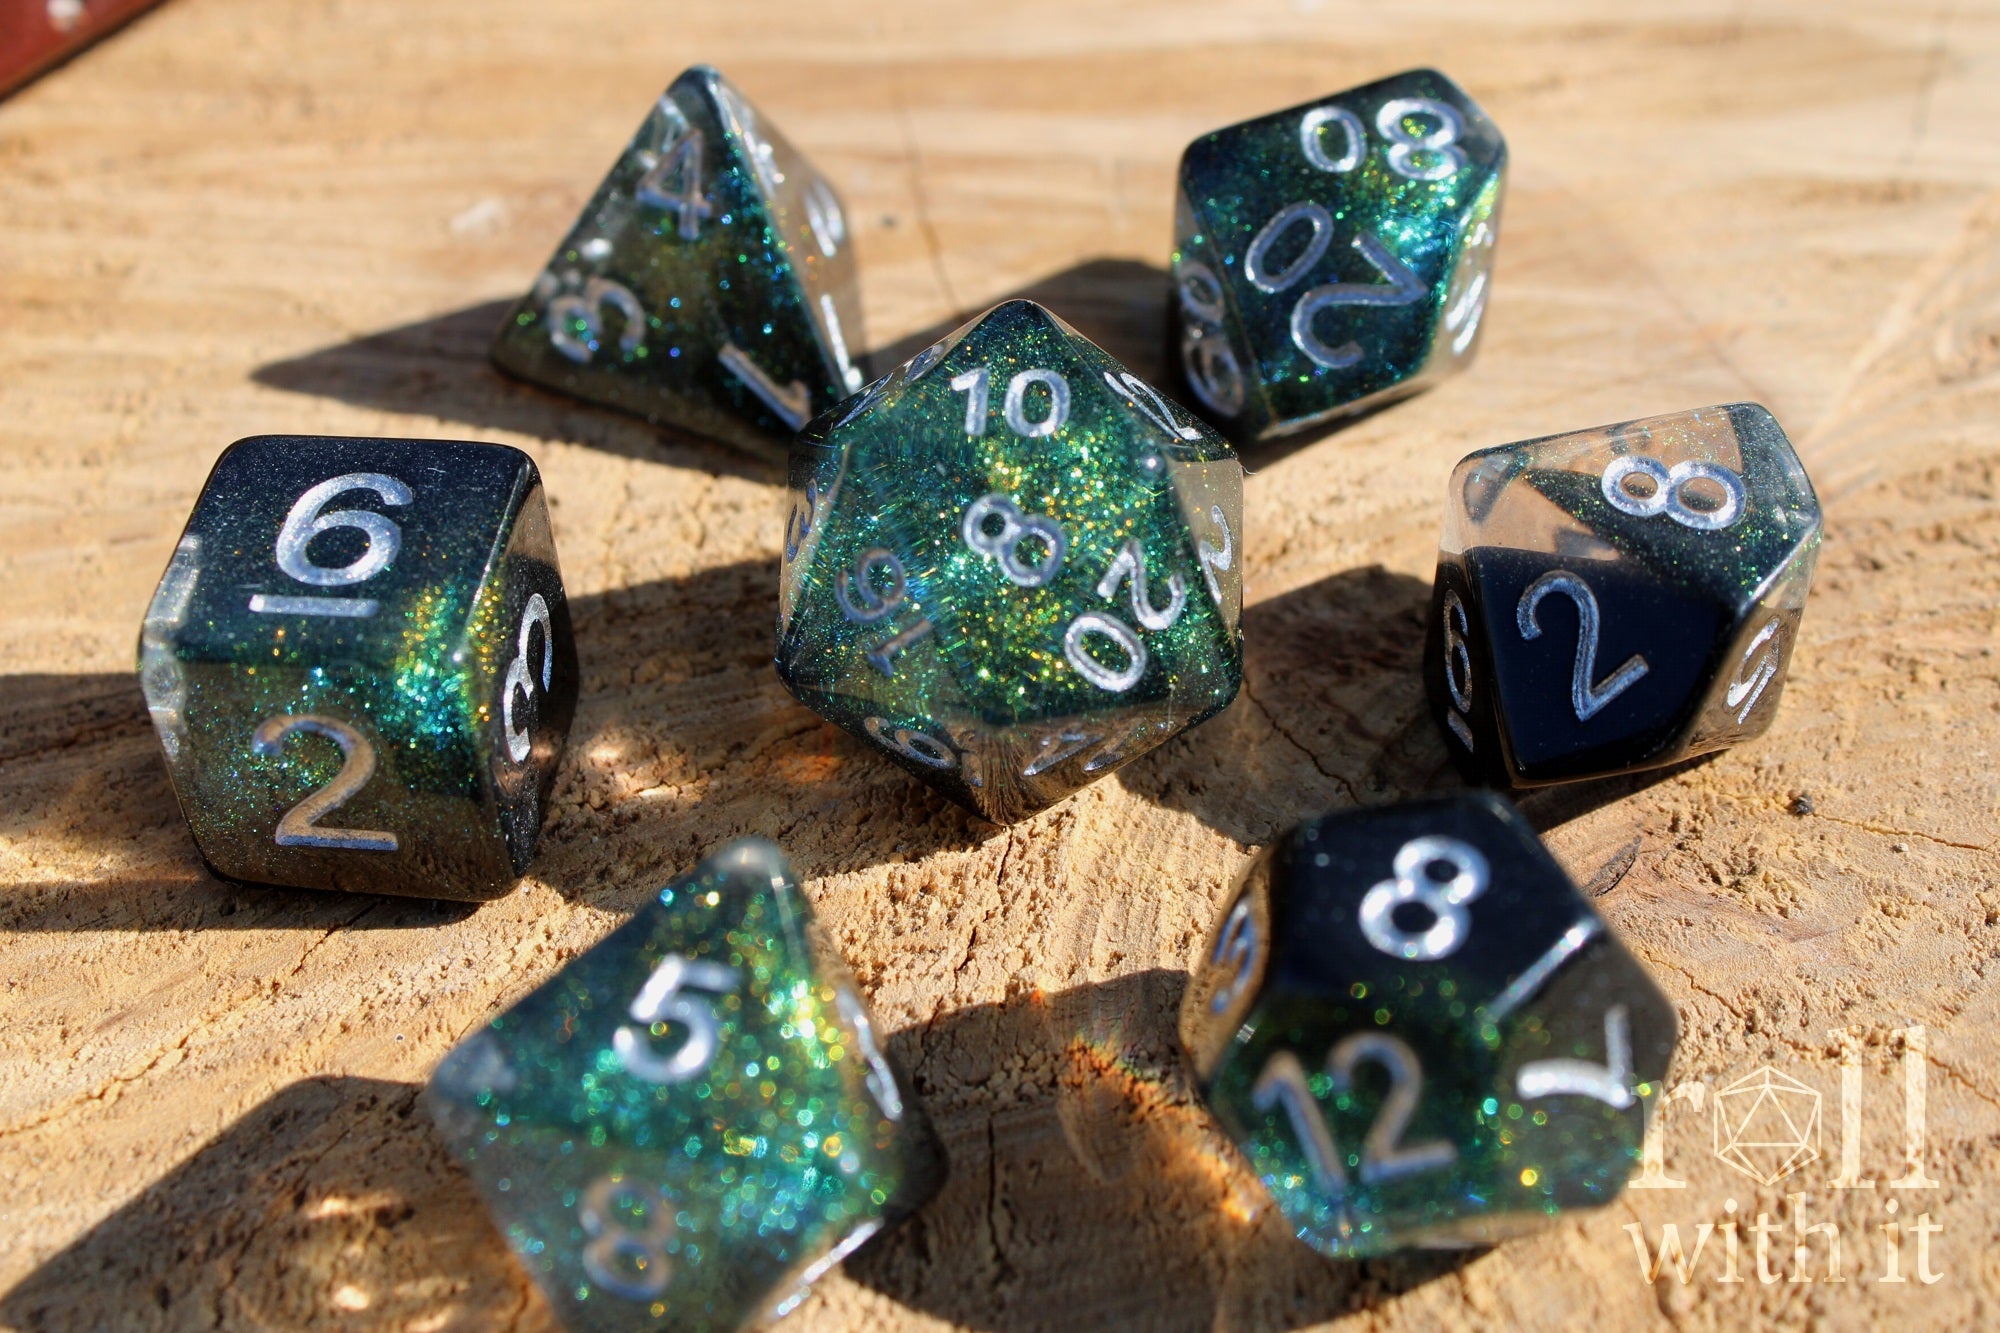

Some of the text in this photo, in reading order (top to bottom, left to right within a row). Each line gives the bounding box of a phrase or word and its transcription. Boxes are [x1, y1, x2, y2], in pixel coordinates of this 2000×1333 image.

[635, 126, 712, 240] 4
[1301, 98, 1469, 181] 80
[951, 367, 1072, 438] 10
[275, 472, 414, 586] 6
[962, 493, 1065, 588] 8
[1601, 455, 1747, 531] 8
[503, 592, 554, 764] 3
[1516, 569, 1650, 722] 2
[251, 714, 399, 851] 2
[1358, 834, 1490, 960] 8
[612, 952, 744, 1084] 5
[1515, 1001, 1636, 1109] 7
[1251, 1031, 1458, 1200] 12
[578, 1175, 677, 1300] 8
